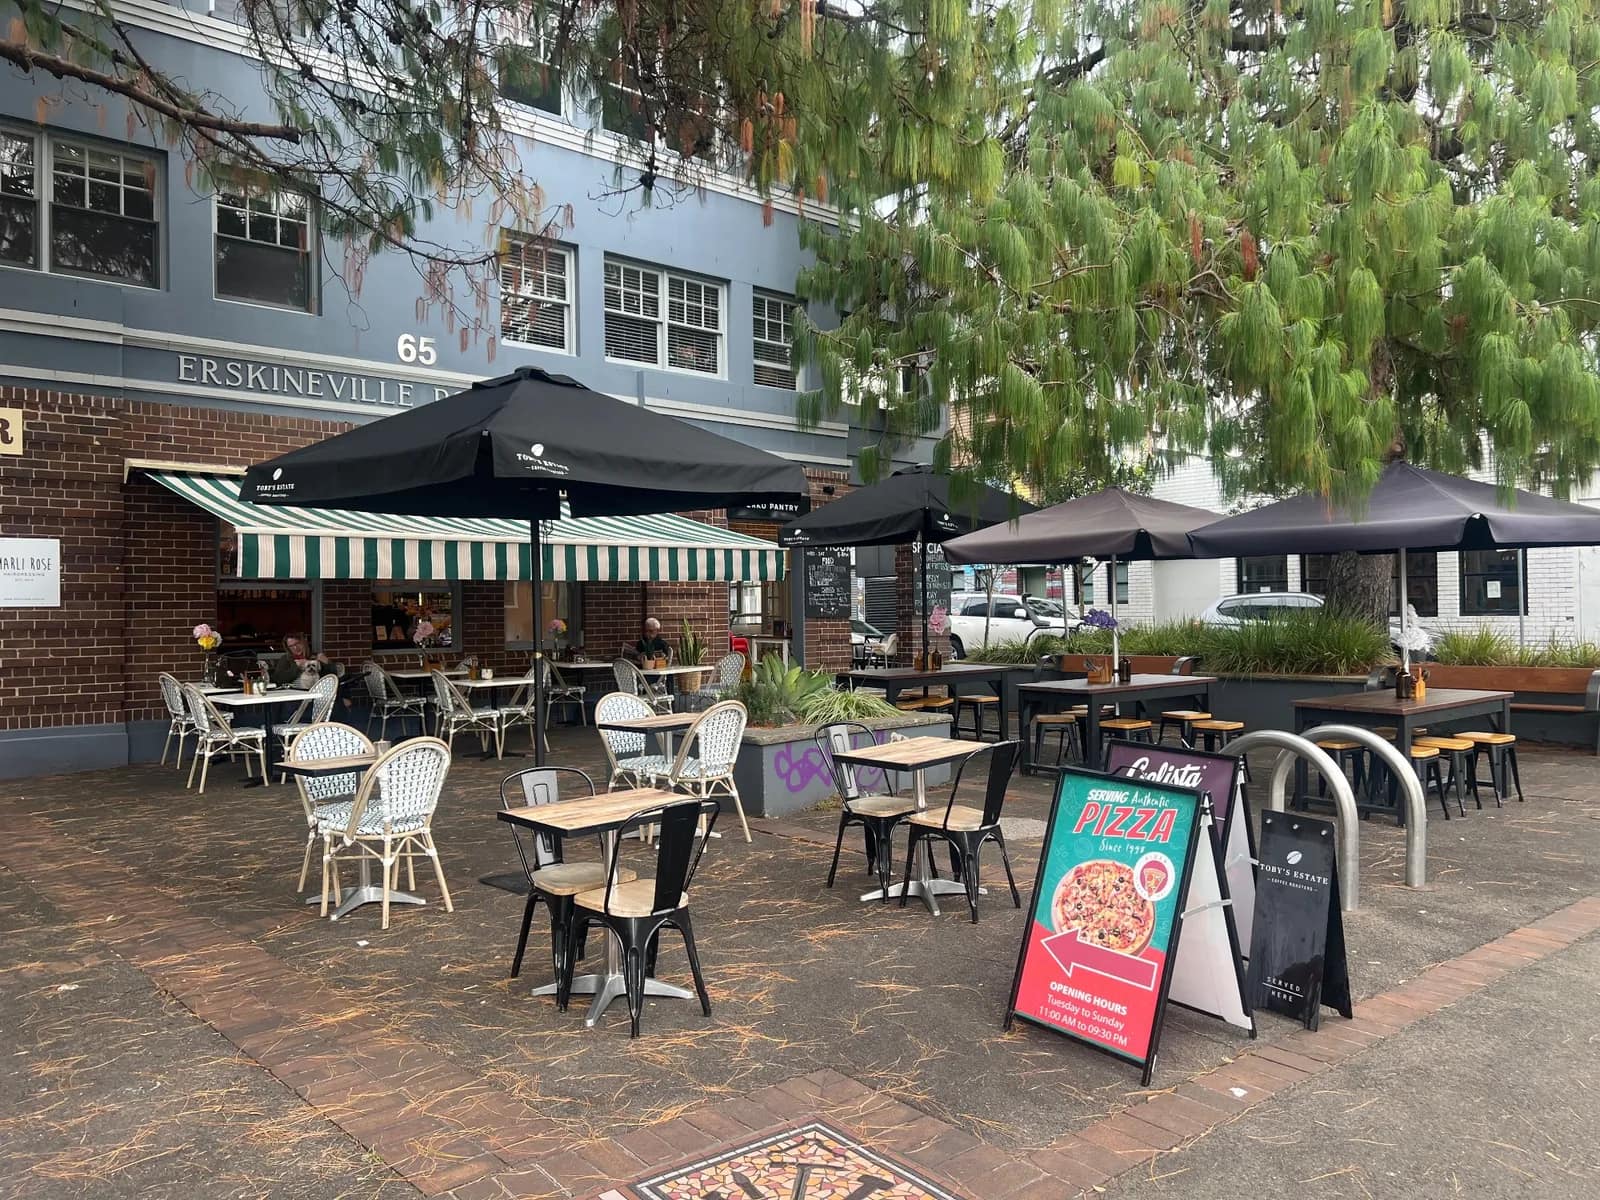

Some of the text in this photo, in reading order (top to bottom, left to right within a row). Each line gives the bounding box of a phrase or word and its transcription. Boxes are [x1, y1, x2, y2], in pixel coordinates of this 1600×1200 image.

[396, 333, 437, 365] 65
[177, 354, 414, 407] ERSKINEVILLE
[769, 503, 799, 512] PANTRY
[912, 541, 944, 554] SPCIA
[0, 556, 53, 571] ARLI ROSE
[1087, 788, 1170, 808] SERVING Authentic
[1072, 801, 1178, 844] PIZZA
[1098, 838, 1122, 853] Since
[1259, 863, 1329, 885] TOBY'S ESTATE
[1266, 976, 1301, 992] SERVED
[1049, 981, 1127, 1016] OPENING HOURS
[1271, 989, 1294, 1002] HERE
[1047, 993, 1125, 1032] Tuesday to Sunday
[1039, 1005, 1128, 1047] 11:00 AM to 09:30 PM
